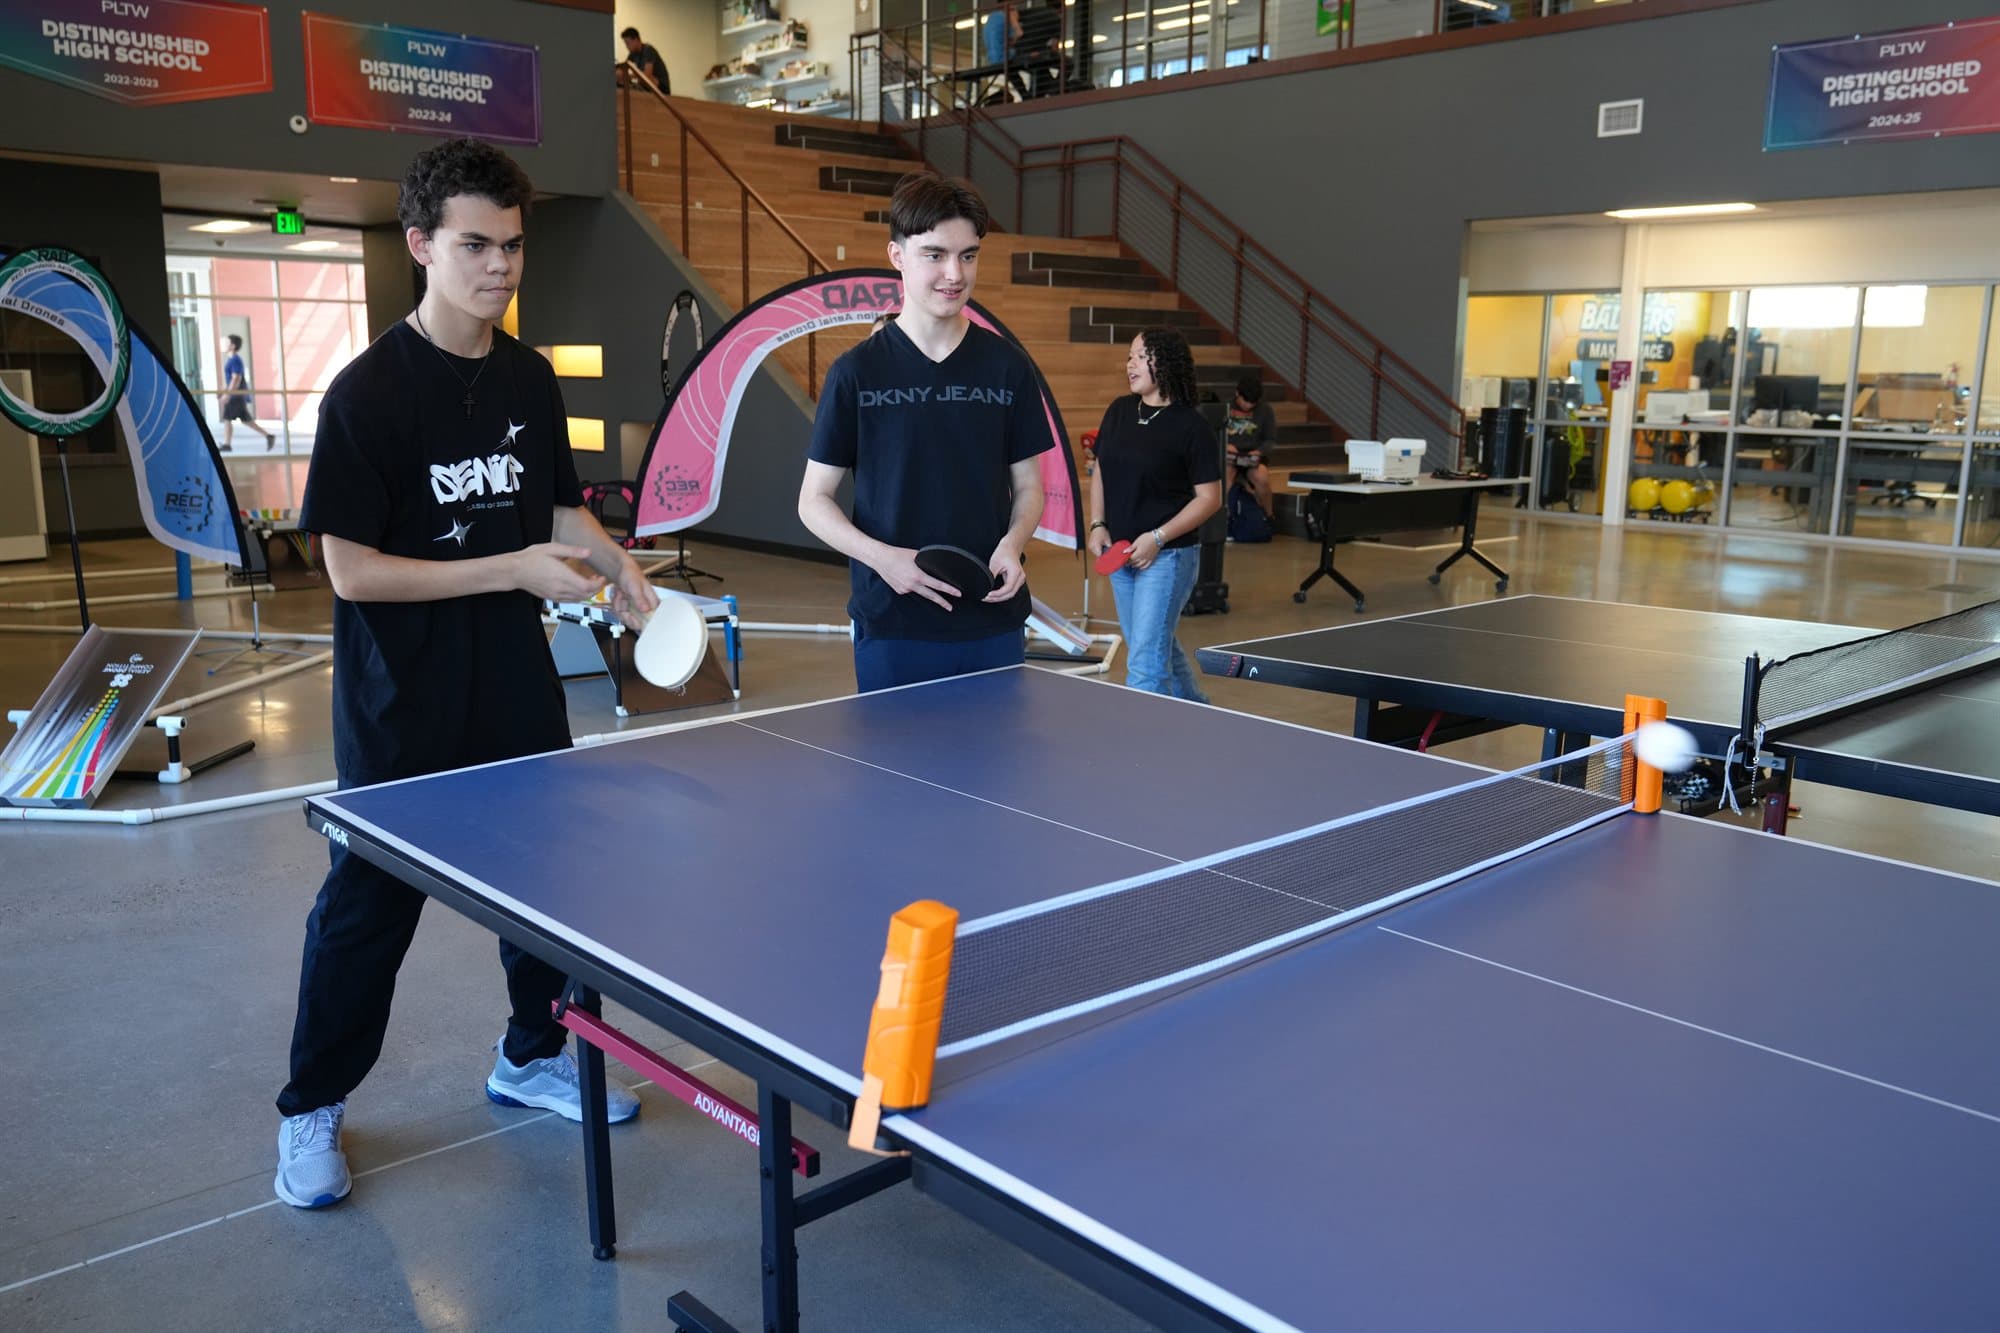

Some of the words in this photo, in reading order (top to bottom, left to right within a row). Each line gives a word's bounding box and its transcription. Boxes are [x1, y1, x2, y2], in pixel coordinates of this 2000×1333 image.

[101, 0, 149, 19] PLTW
[42, 19, 210, 56] DISTINGUISHED
[407, 40, 446, 57] PLTW
[53, 38, 110, 61] HIGH
[115, 46, 203, 72] SCHOOL
[1879, 40, 1926, 58] PLTW
[103, 73, 159, 89] 2022-2023
[360, 59, 493, 90] DISTINGUISHED
[1822, 60, 1982, 93] DISTINGUISHED
[368, 75, 414, 95] HIGH
[418, 82, 487, 104] SCHOOL
[1829, 87, 1880, 108] HIGH
[1883, 78, 1969, 101] SCHOOL
[407, 108, 452, 123] 2023-24
[1867, 111, 1922, 128] 2024-25
[21, 300, 65, 326] Drones
[859, 386, 933, 408] DKNY
[165, 492, 203, 507] REC
